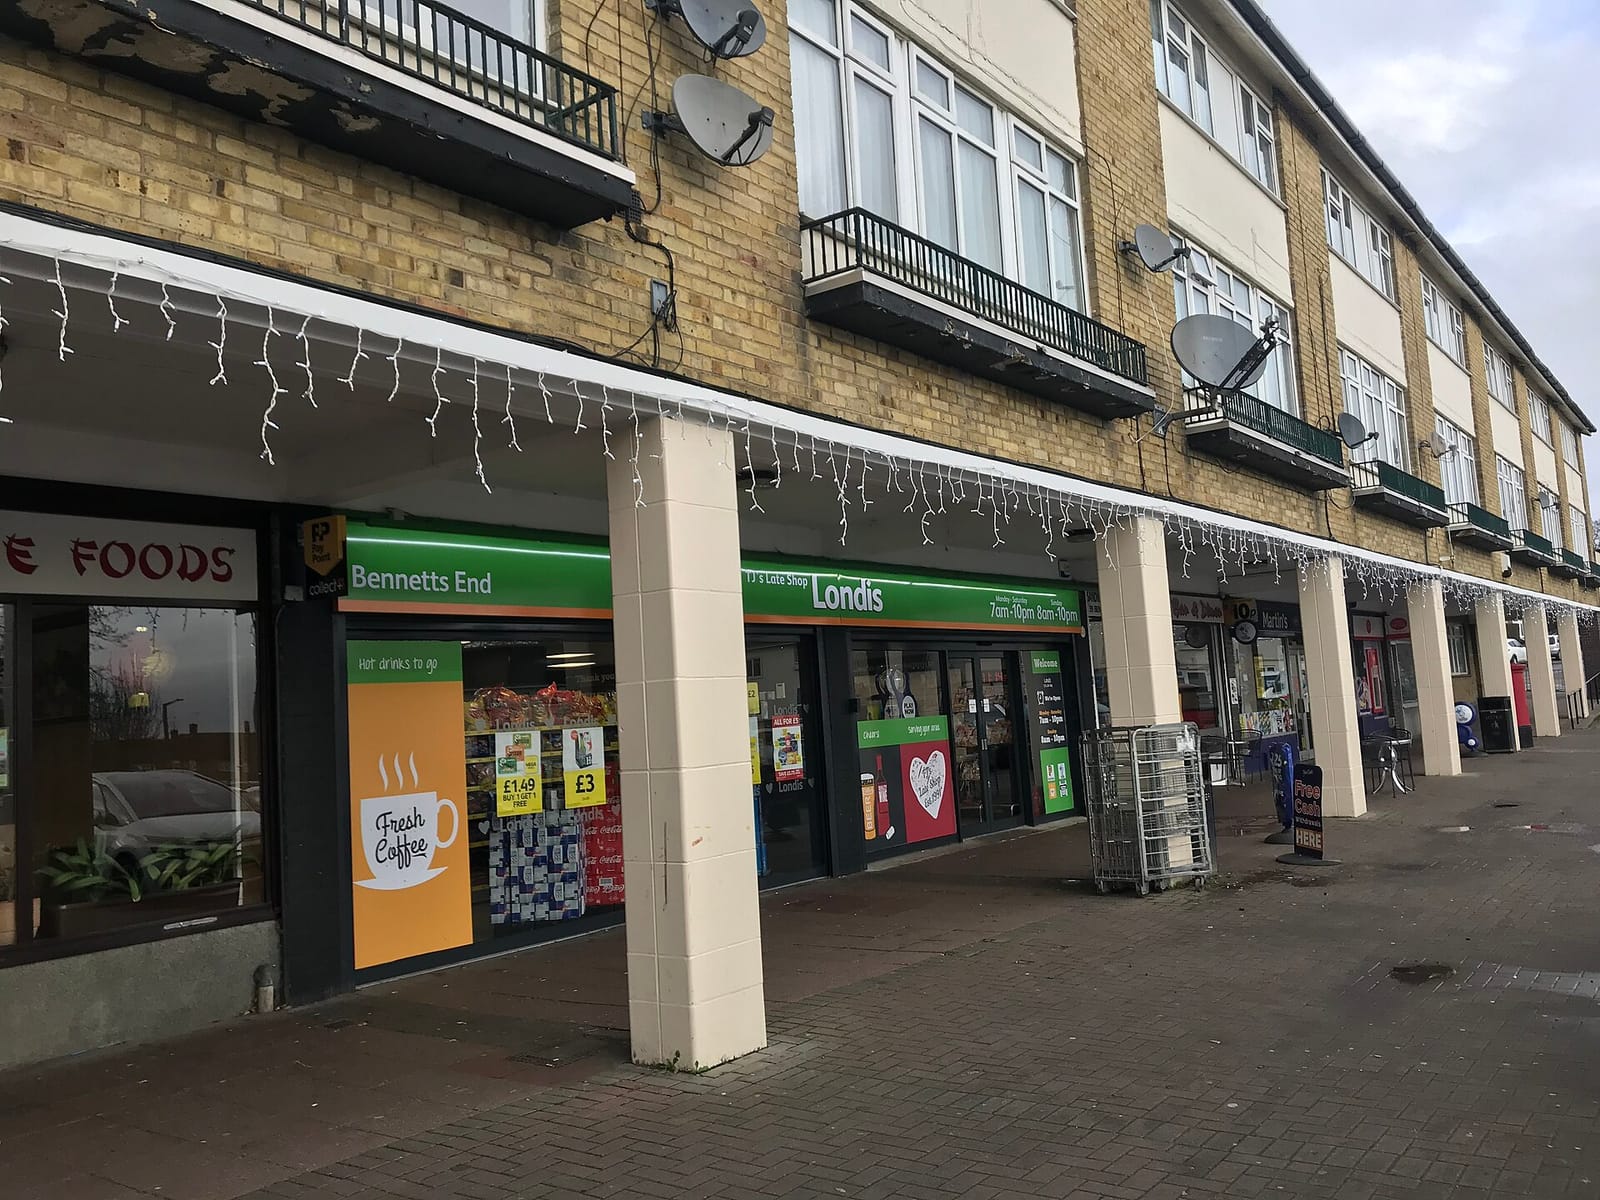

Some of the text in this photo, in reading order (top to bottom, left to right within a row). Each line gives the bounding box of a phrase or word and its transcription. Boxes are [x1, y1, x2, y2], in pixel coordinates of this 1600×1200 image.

[70, 537, 236, 582] FOODS
[351, 564, 492, 594] Bennetts End
[766, 571, 785, 585] Late
[786, 573, 809, 590] Shop
[811, 574, 884, 612] Londis
[1262, 611, 1289, 629] Martin's
[358, 657, 438, 675] Hot drinks to go
[1033, 658, 1058, 668] Welcome
[774, 703, 799, 717] Londis
[773, 718, 782, 726] ALL
[783, 718, 792, 726] FOR
[503, 778, 536, 794] £1.49
[575, 773, 595, 794] £3
[778, 779, 804, 793] Londis
[1295, 779, 1321, 800] Free
[502, 792, 517, 802] BUY
[520, 792, 532, 800] GET
[513, 800, 528, 809] FREE
[864, 795, 873, 830] BEER
[1295, 798, 1321, 818] Cash
[375, 806, 425, 838] Fresh
[1295, 828, 1322, 849] HERE
[375, 834, 428, 870] Coffee
